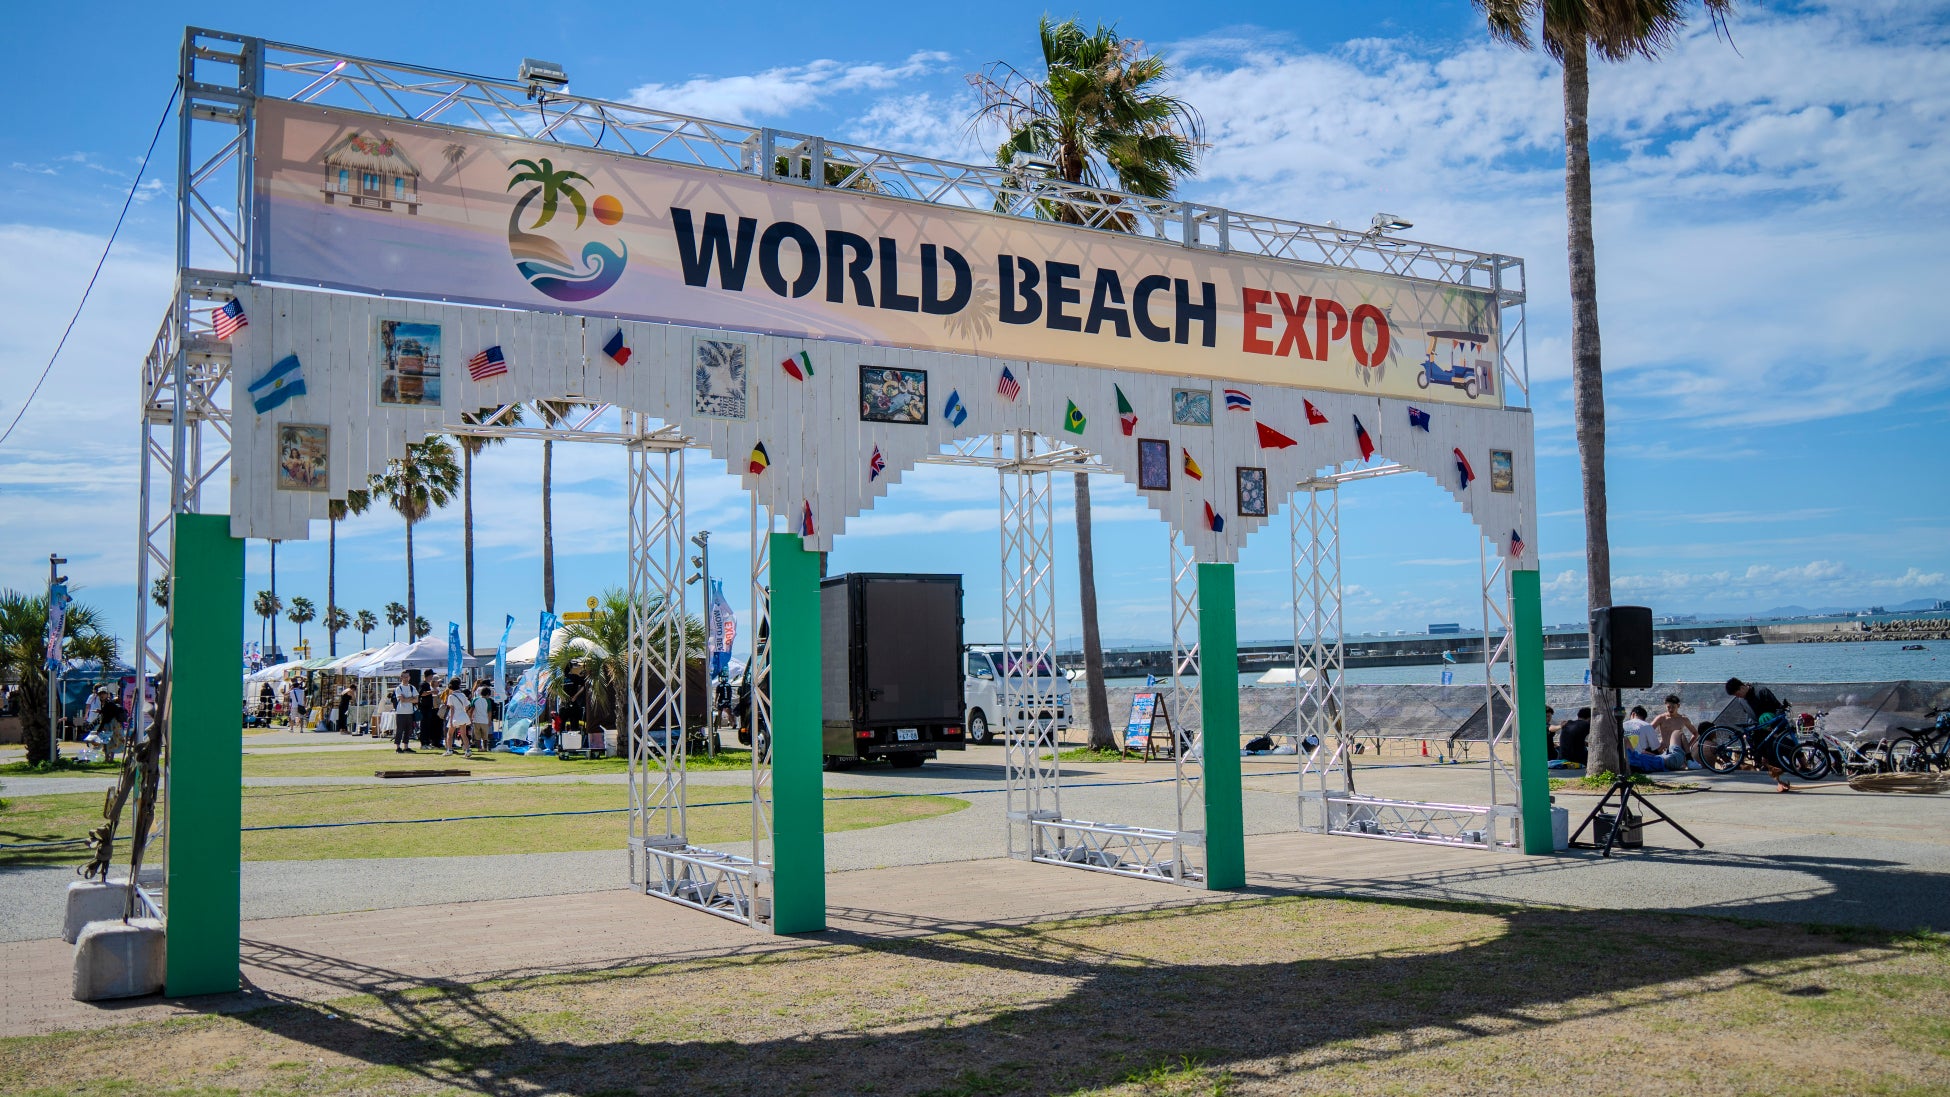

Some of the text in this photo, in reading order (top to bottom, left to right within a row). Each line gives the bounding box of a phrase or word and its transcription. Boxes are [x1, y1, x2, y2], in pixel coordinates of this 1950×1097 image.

[670, 207, 1390, 368] WORLD BEACH EXPO
